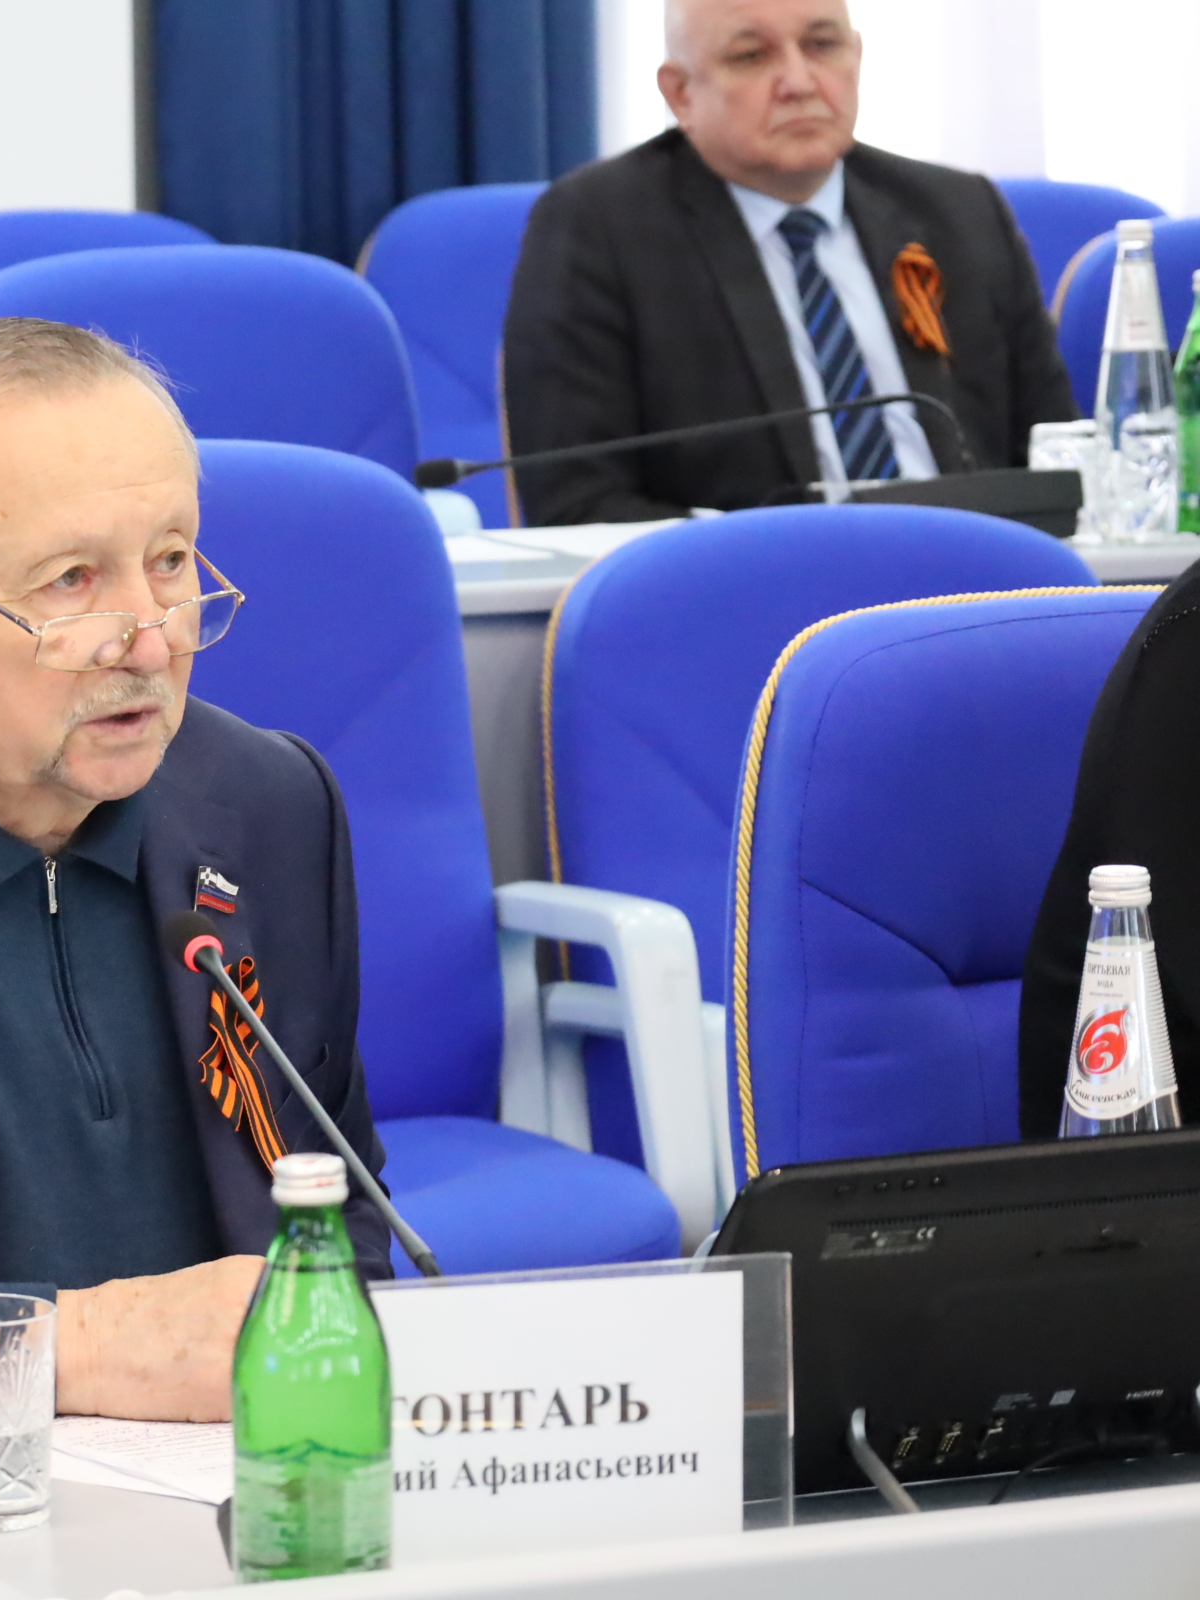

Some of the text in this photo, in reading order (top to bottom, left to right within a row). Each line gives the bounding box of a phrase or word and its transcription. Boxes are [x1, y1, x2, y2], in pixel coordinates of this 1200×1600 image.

[1087, 962, 1131, 976] ПИТЬЕВАЯ
[393, 1451, 699, 1495] ий Афанасьевич
